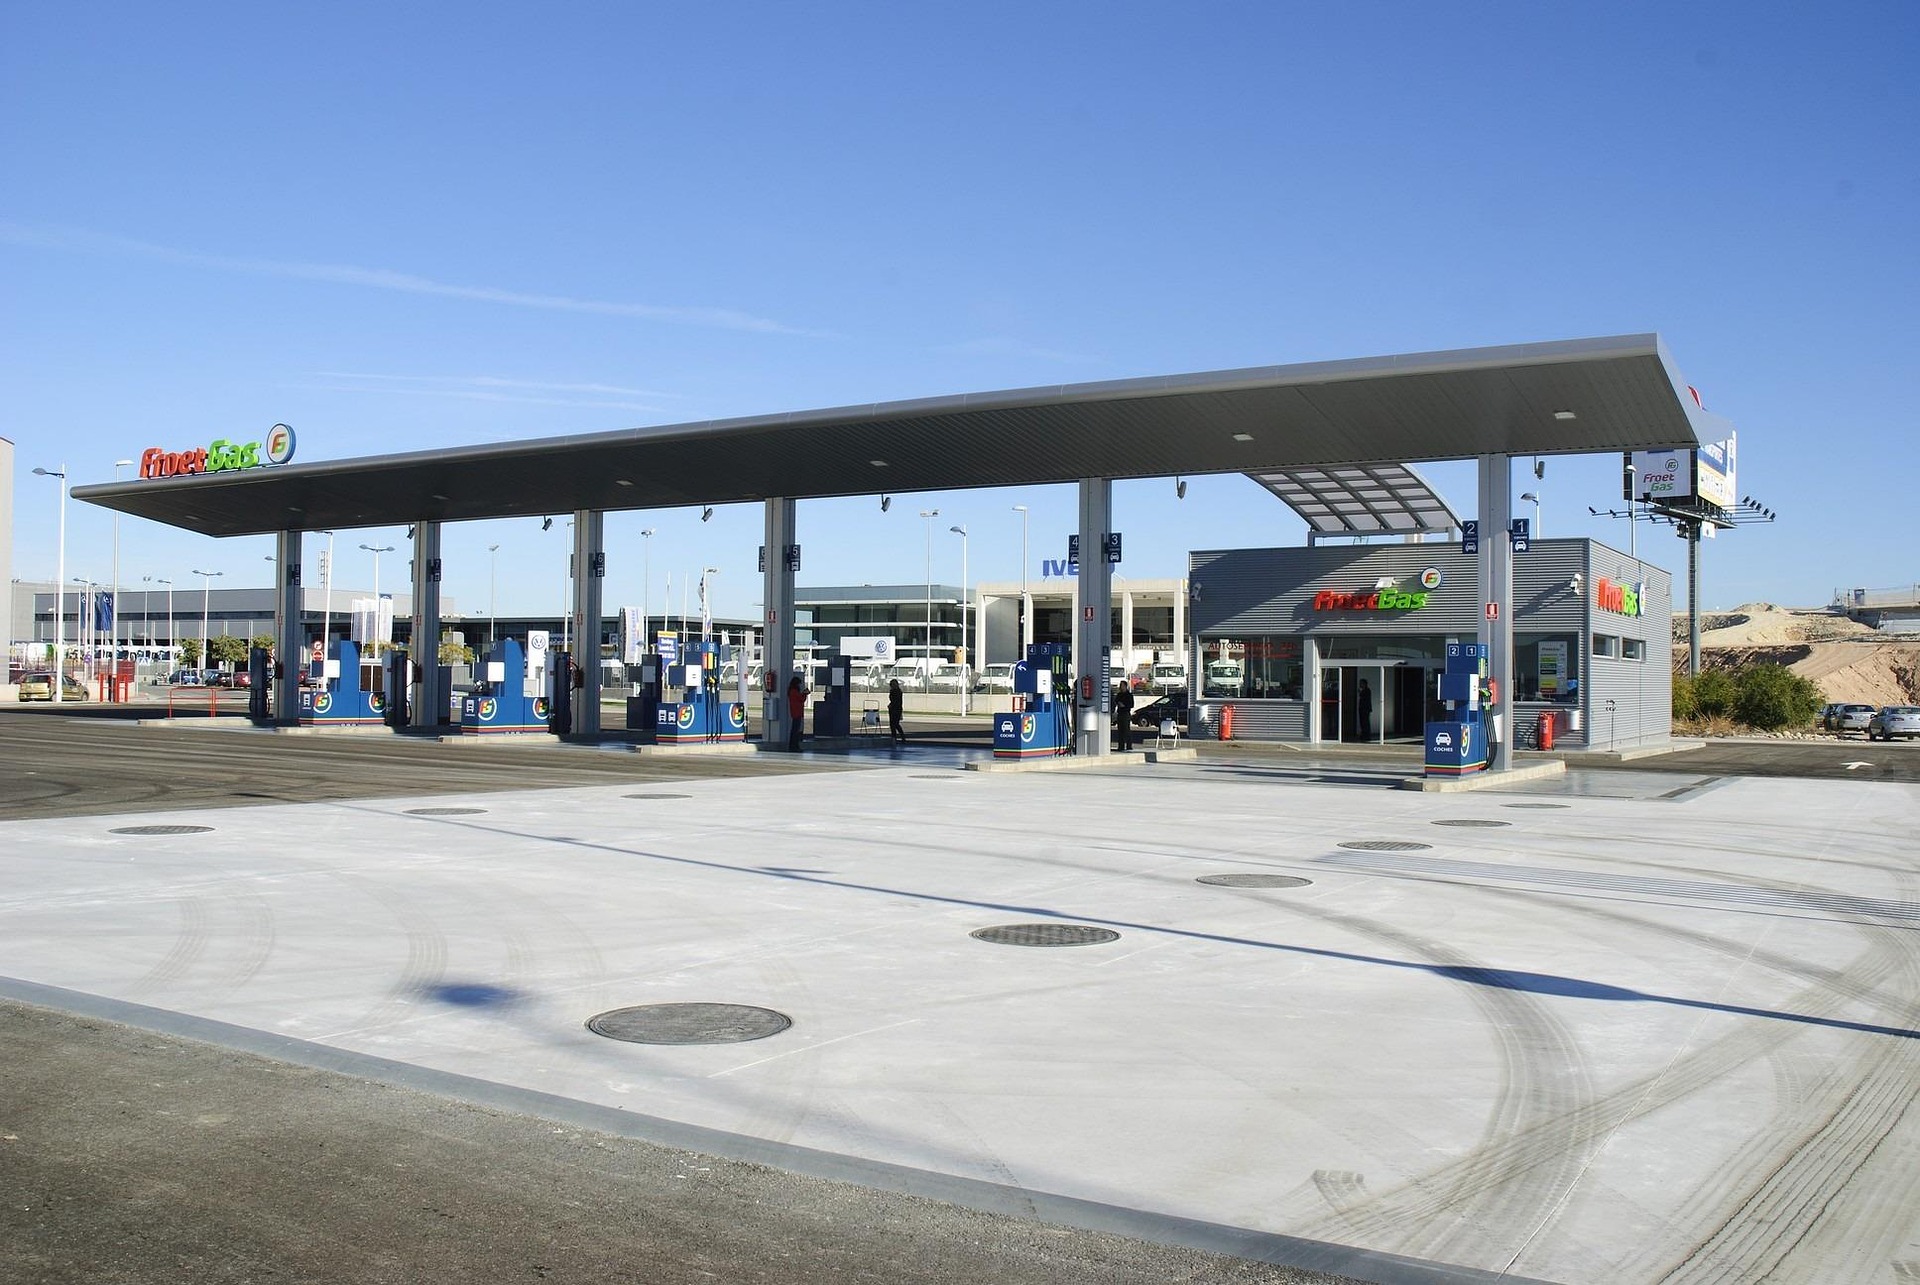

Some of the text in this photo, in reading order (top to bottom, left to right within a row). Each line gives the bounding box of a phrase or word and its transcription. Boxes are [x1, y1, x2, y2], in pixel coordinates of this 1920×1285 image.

[1643, 473, 1675, 483] Froet
[1650, 482, 1673, 491] Gas
[1467, 522, 1475, 534] 2
[1518, 521, 1524, 532] 1
[1072, 536, 1079, 547] 4
[1111, 534, 1119, 545] 3
